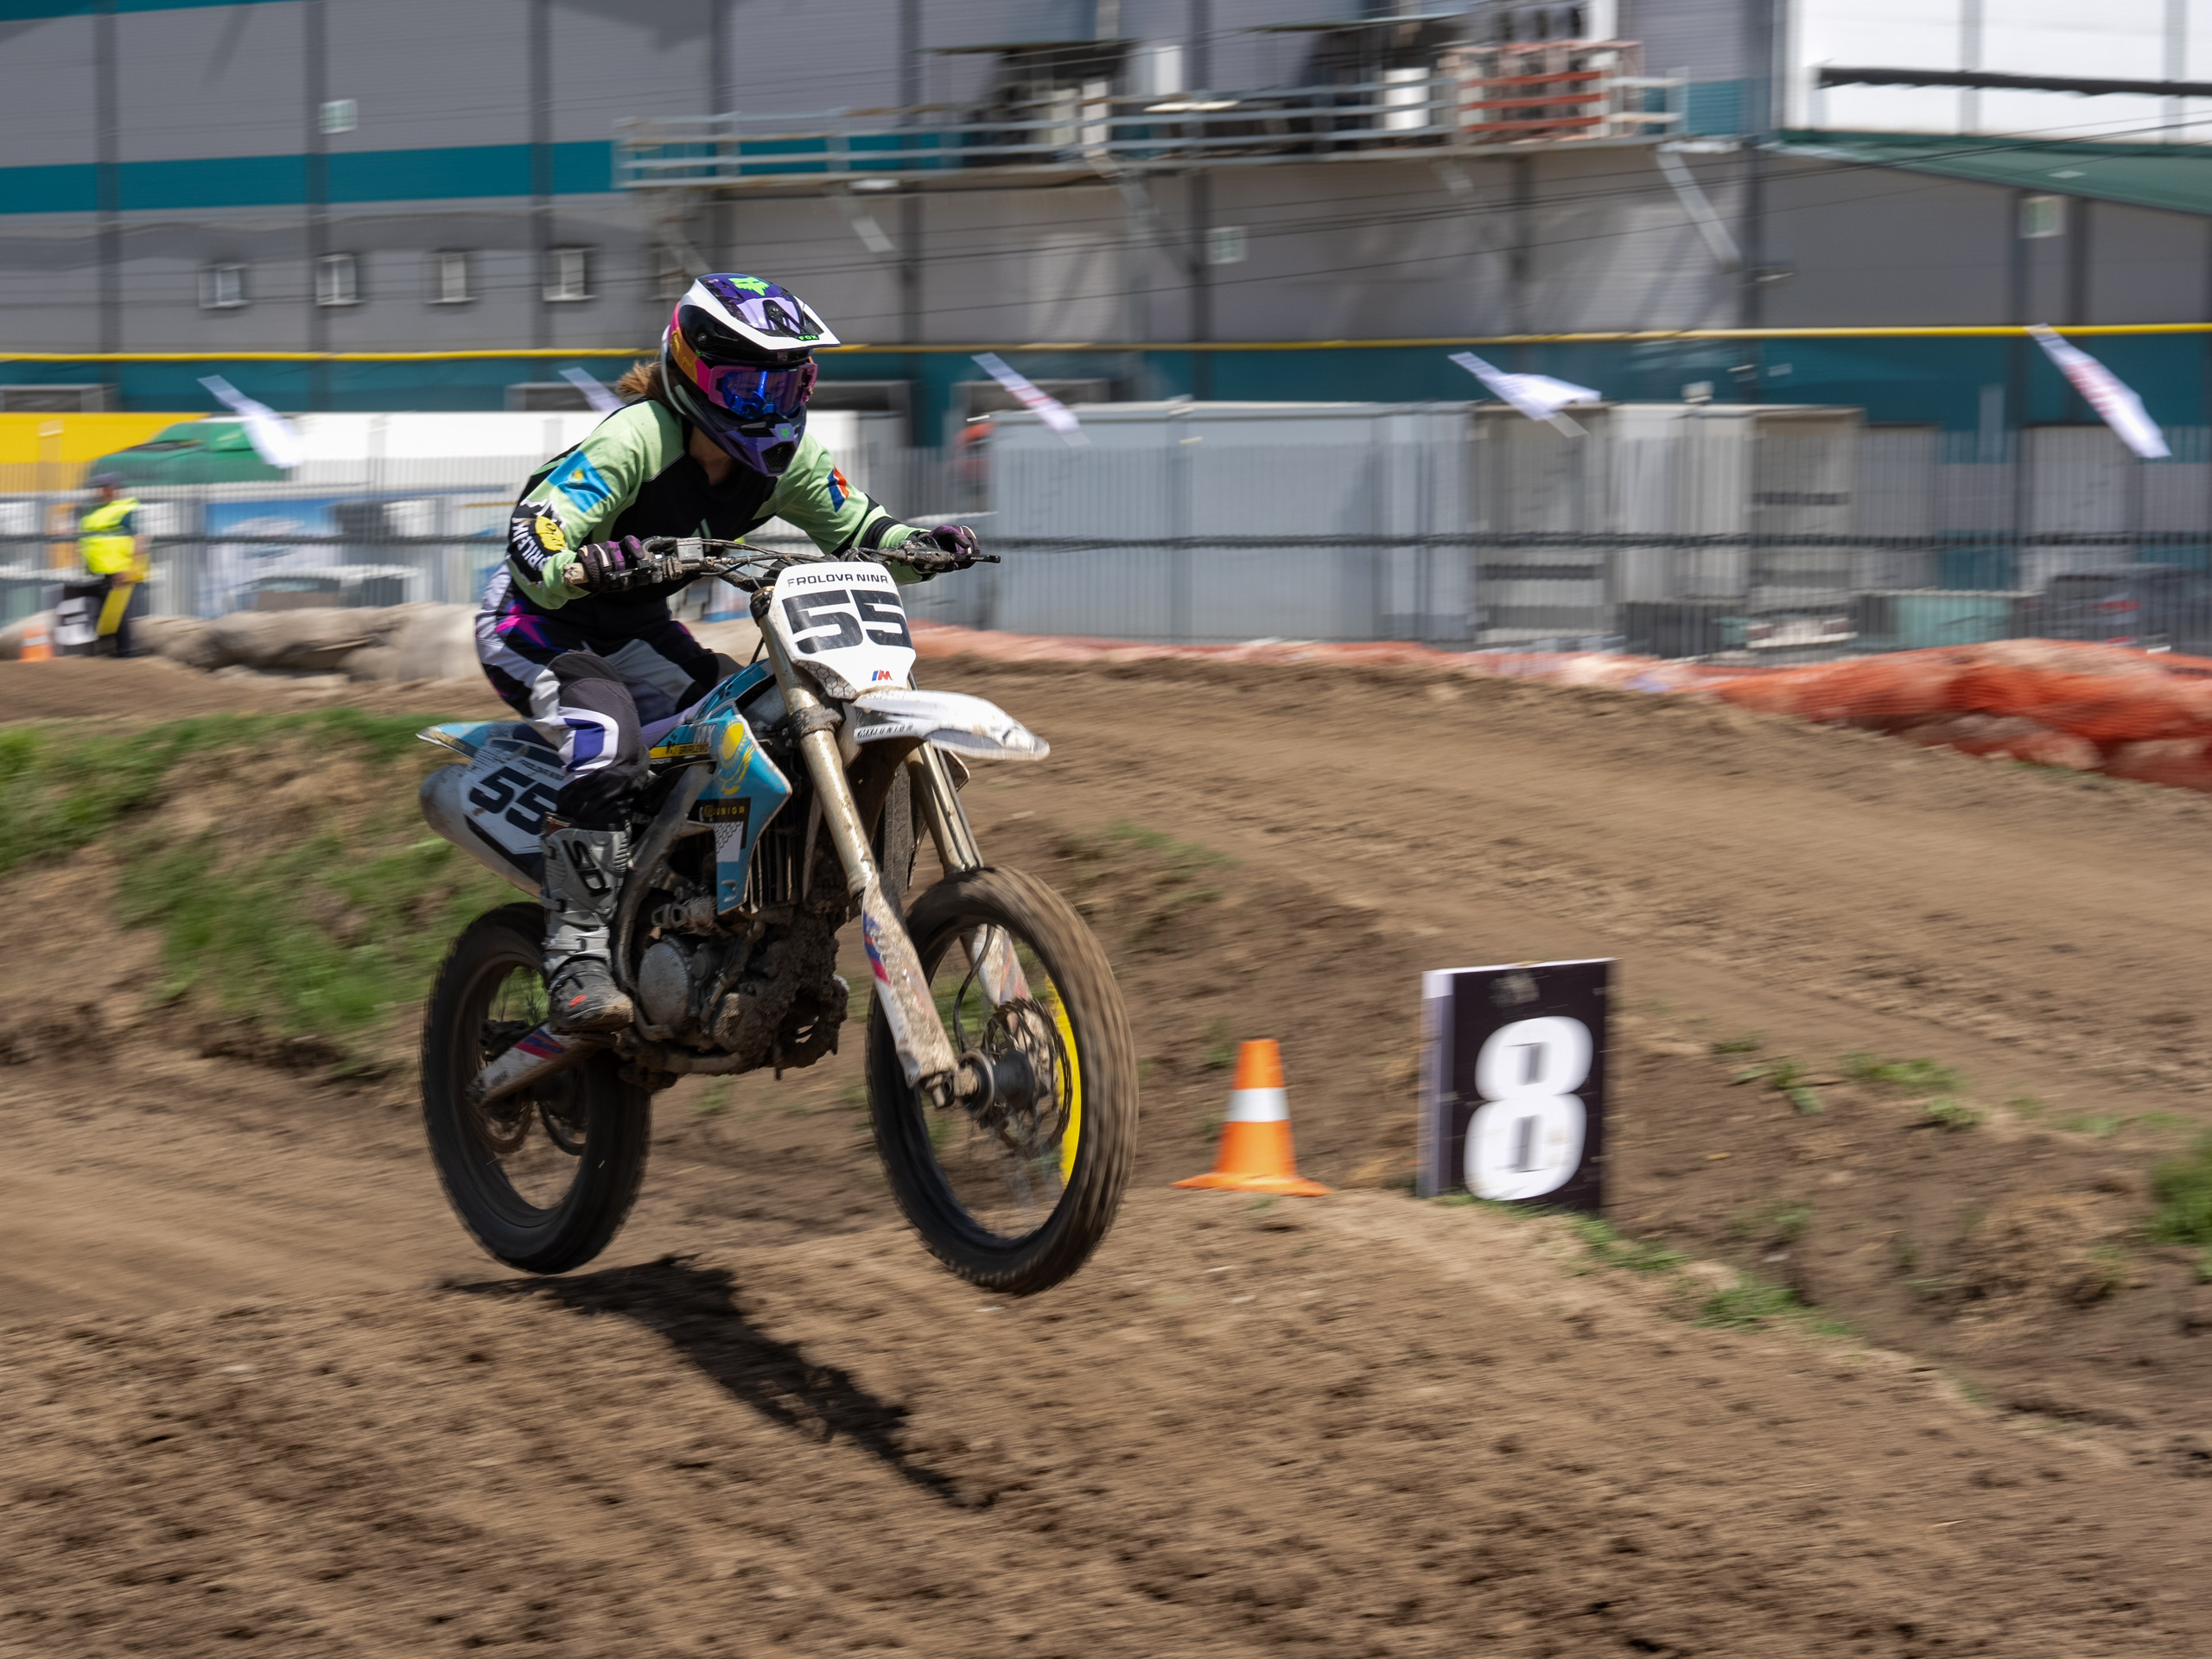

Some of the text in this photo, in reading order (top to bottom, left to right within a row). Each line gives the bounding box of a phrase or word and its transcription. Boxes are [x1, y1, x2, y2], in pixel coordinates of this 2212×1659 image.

[787, 574, 888, 588] FROLOVA NINA
[781, 588, 916, 655] 55
[468, 766, 559, 836] 55
[1464, 1015, 1593, 1201] 8
